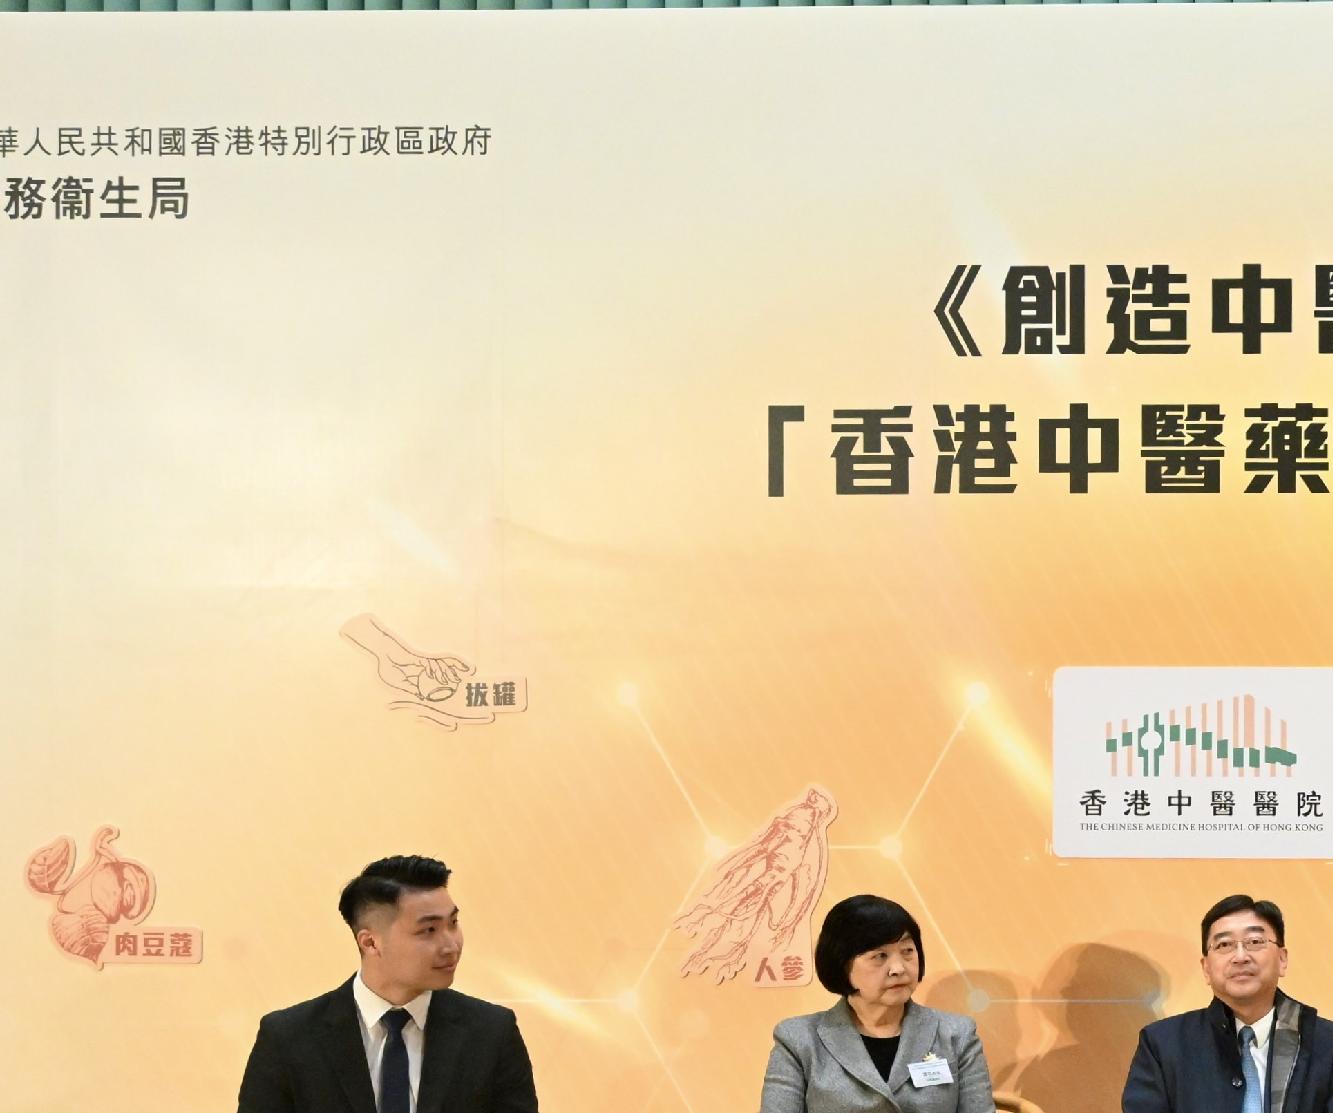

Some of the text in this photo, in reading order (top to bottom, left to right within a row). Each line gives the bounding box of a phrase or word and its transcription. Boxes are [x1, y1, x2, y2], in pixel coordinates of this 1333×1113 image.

[0, 125, 492, 159] 華人民共和國香港特別行政區政府
[465, 682, 516, 707] 拔罐
[1079, 789, 1324, 817] 香港中醫醫院
[1080, 823, 1324, 832] THE CHINESE MEDICINE HOSPITAL OF HONG KONG
[115, 932, 192, 957] 肉豆蔻
[755, 956, 804, 982] 人參
